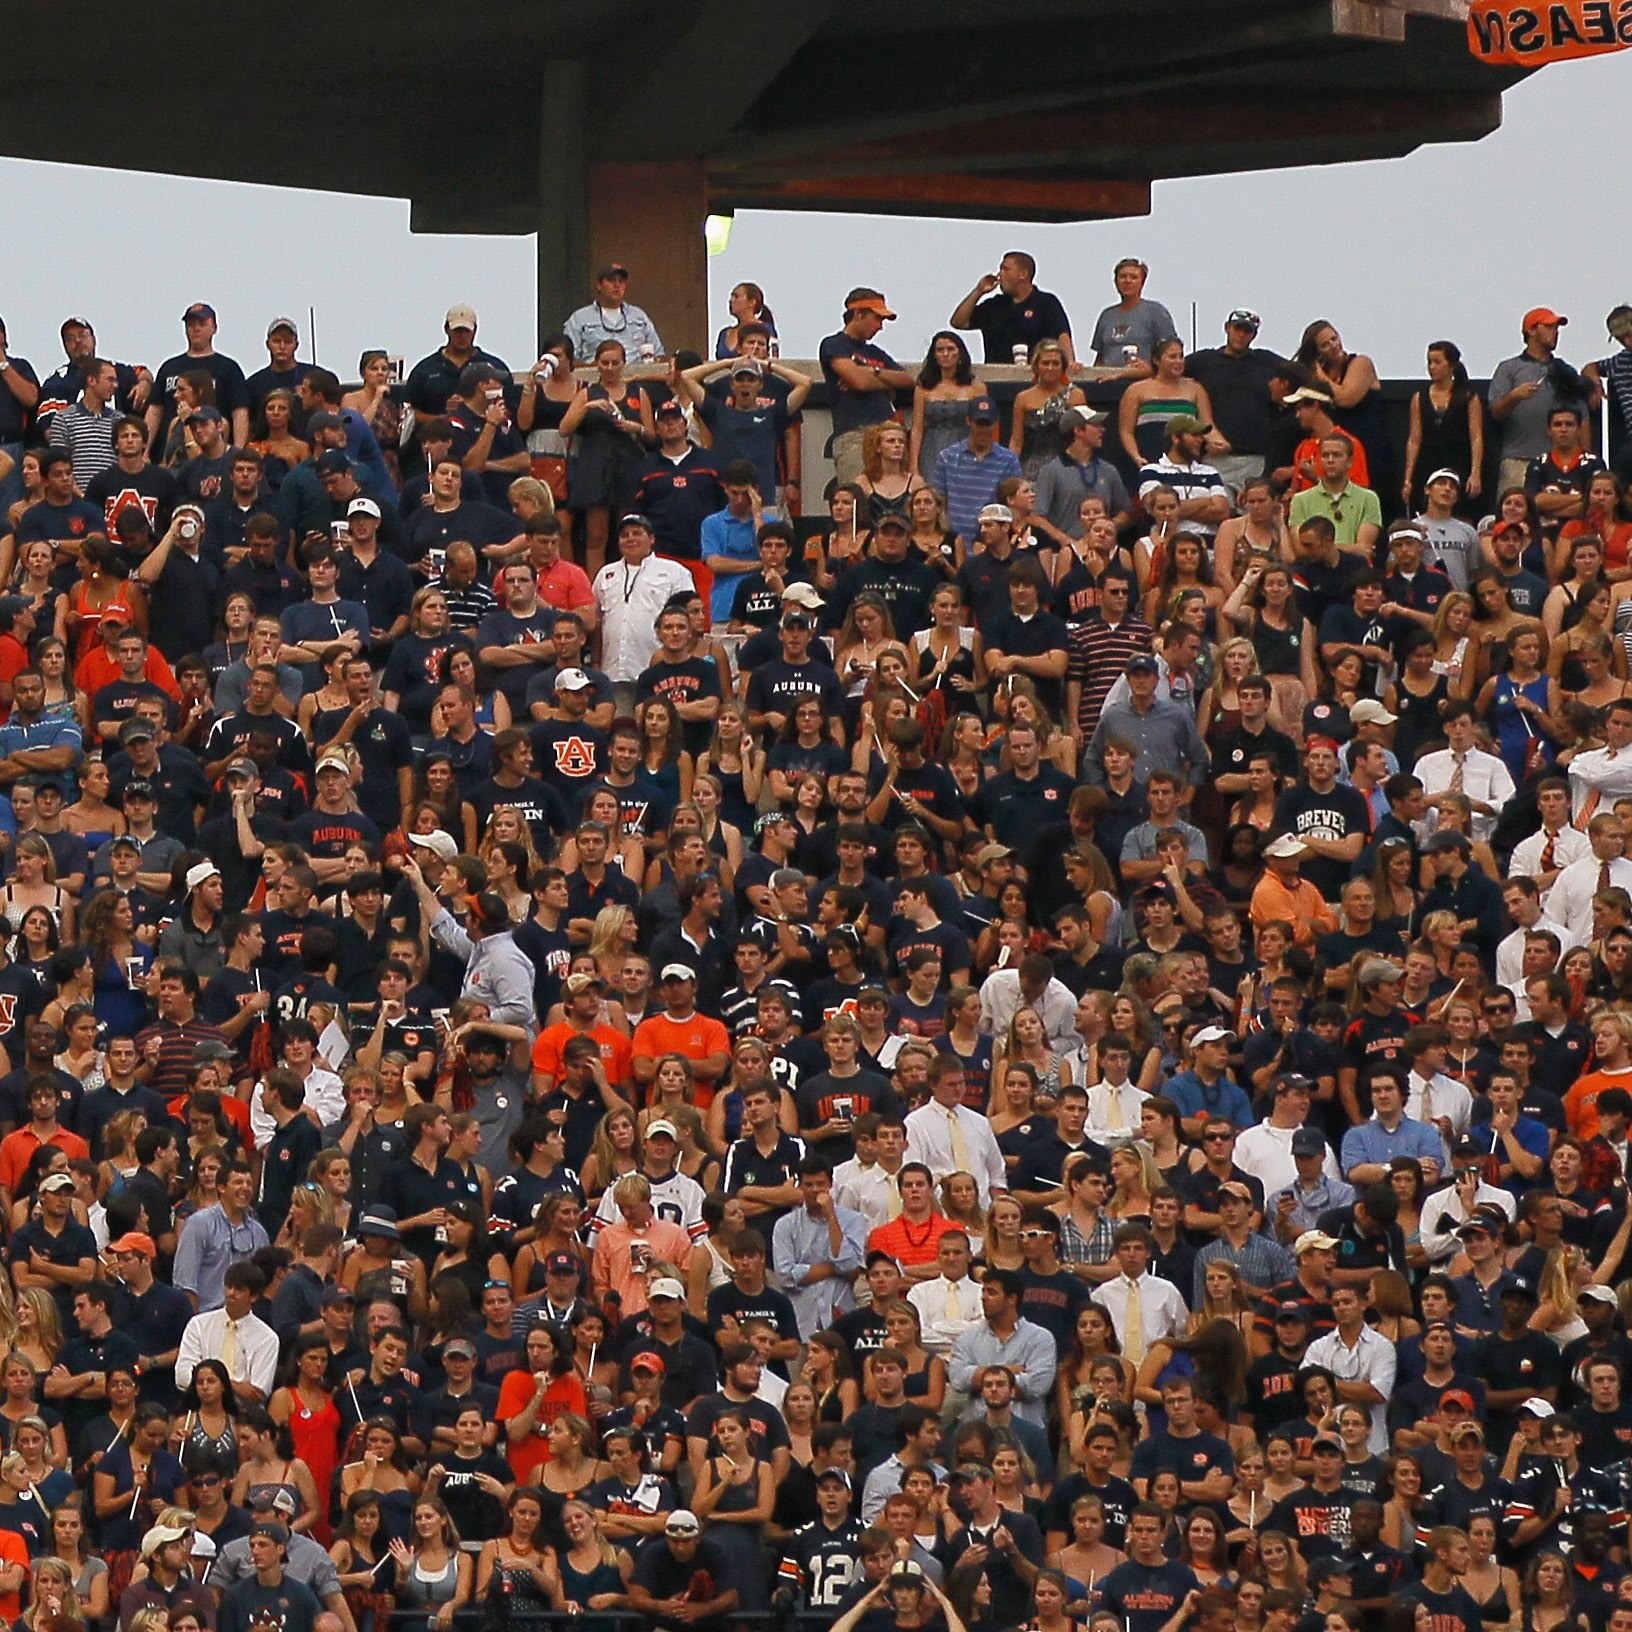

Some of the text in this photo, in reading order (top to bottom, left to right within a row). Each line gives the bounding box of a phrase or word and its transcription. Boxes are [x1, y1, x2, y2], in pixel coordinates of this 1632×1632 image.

[772, 681, 822, 695] AUBURN
[552, 735, 597, 778] AU
[312, 827, 363, 845] AUBURN
[808, 1553, 855, 1607] 12
